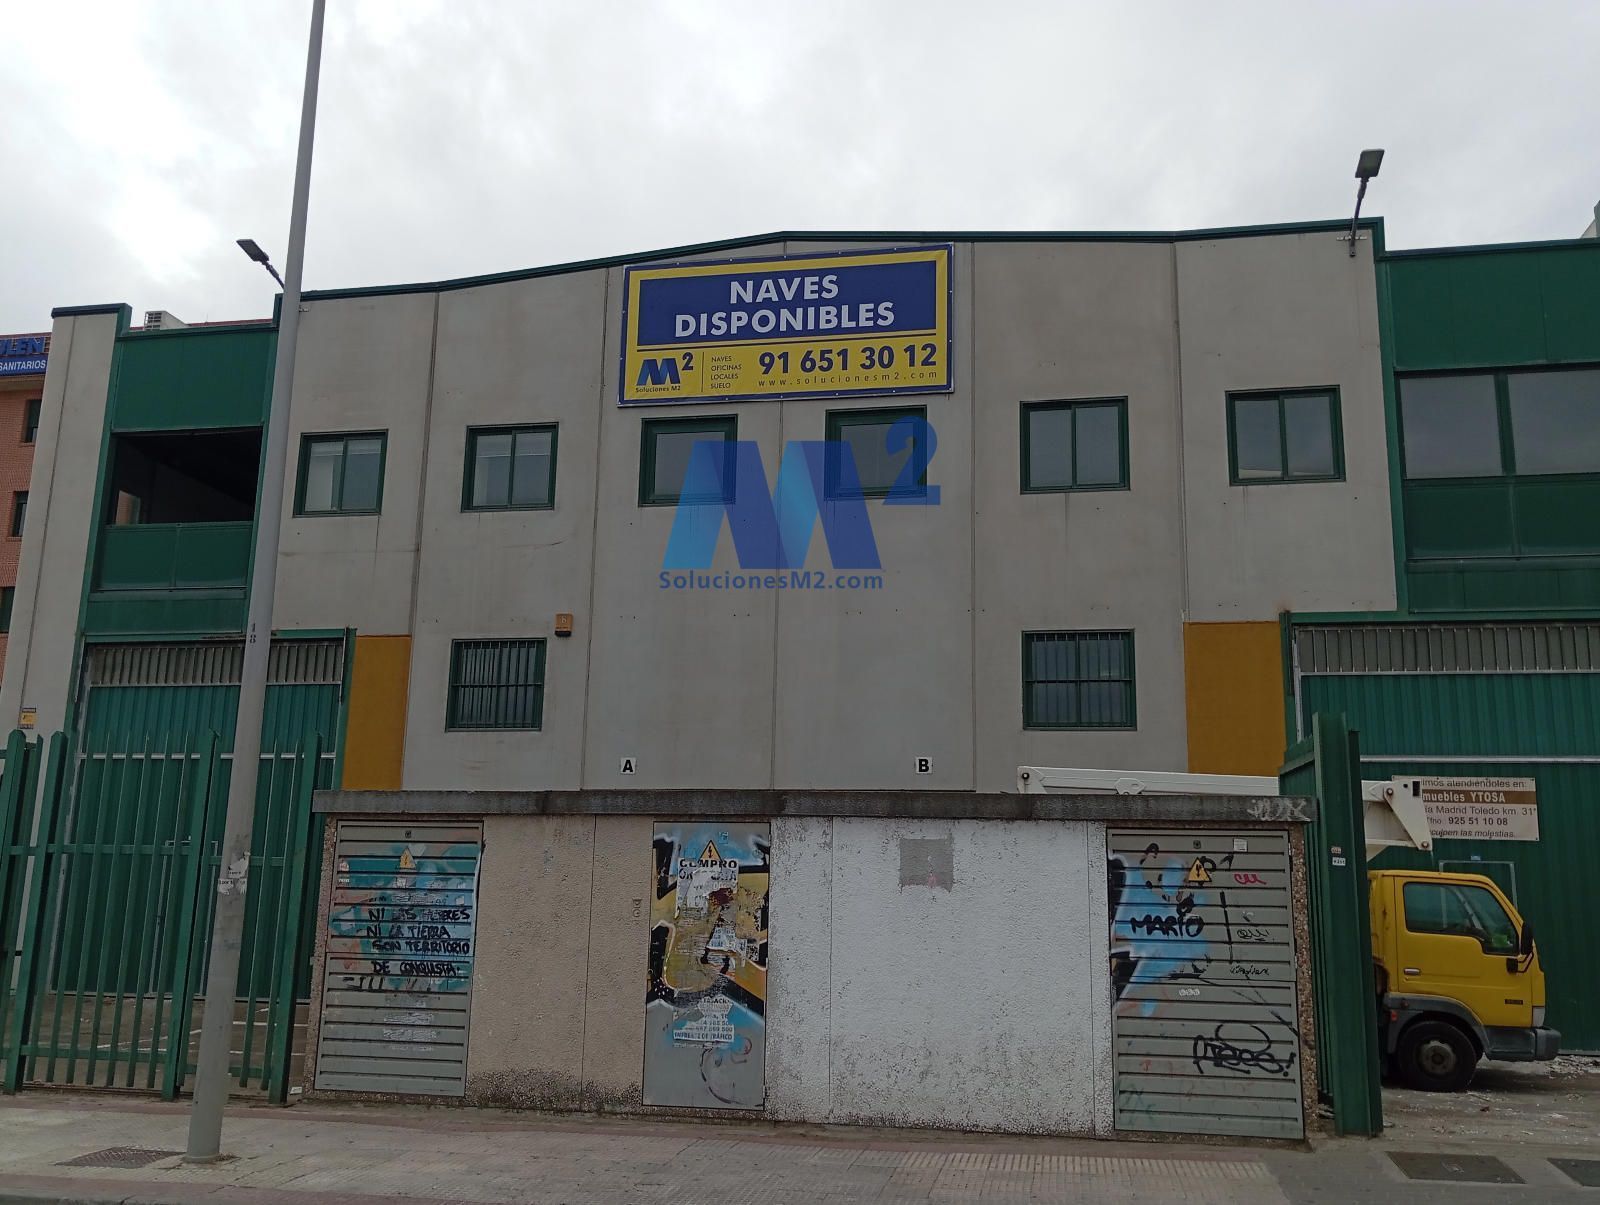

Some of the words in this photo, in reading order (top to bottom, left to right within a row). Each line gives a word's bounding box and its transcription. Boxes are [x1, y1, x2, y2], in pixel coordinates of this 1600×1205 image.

[730, 274, 840, 304] NAVES
[674, 301, 895, 338] DISPONIBLES
[758, 350, 789, 375] 91
[800, 347, 849, 374] 651
[859, 344, 895, 370] 30
[903, 342, 938, 367] 12
[0, 360, 47, 372] SANITARIOS
[710, 364, 742, 372] OFICINAS
[710, 373, 739, 381] LOCALES
[758, 371, 938, 387] www.solucionesm2.com
[622, 759, 634, 773] A
[917, 758, 930, 772] B
[1470, 792, 1506, 803] YTOSA
[1436, 805, 1467, 814] Madrid
[1469, 806, 1500, 815] Toledo
[1448, 816, 1466, 825] 925
[1468, 817, 1479, 825] 51
[1482, 817, 1494, 825] 10
[1496, 818, 1508, 826] 08
[1460, 829, 1473, 837] las
[405, 940, 470, 955] TERRITORIO
[371, 960, 391, 975] DE
